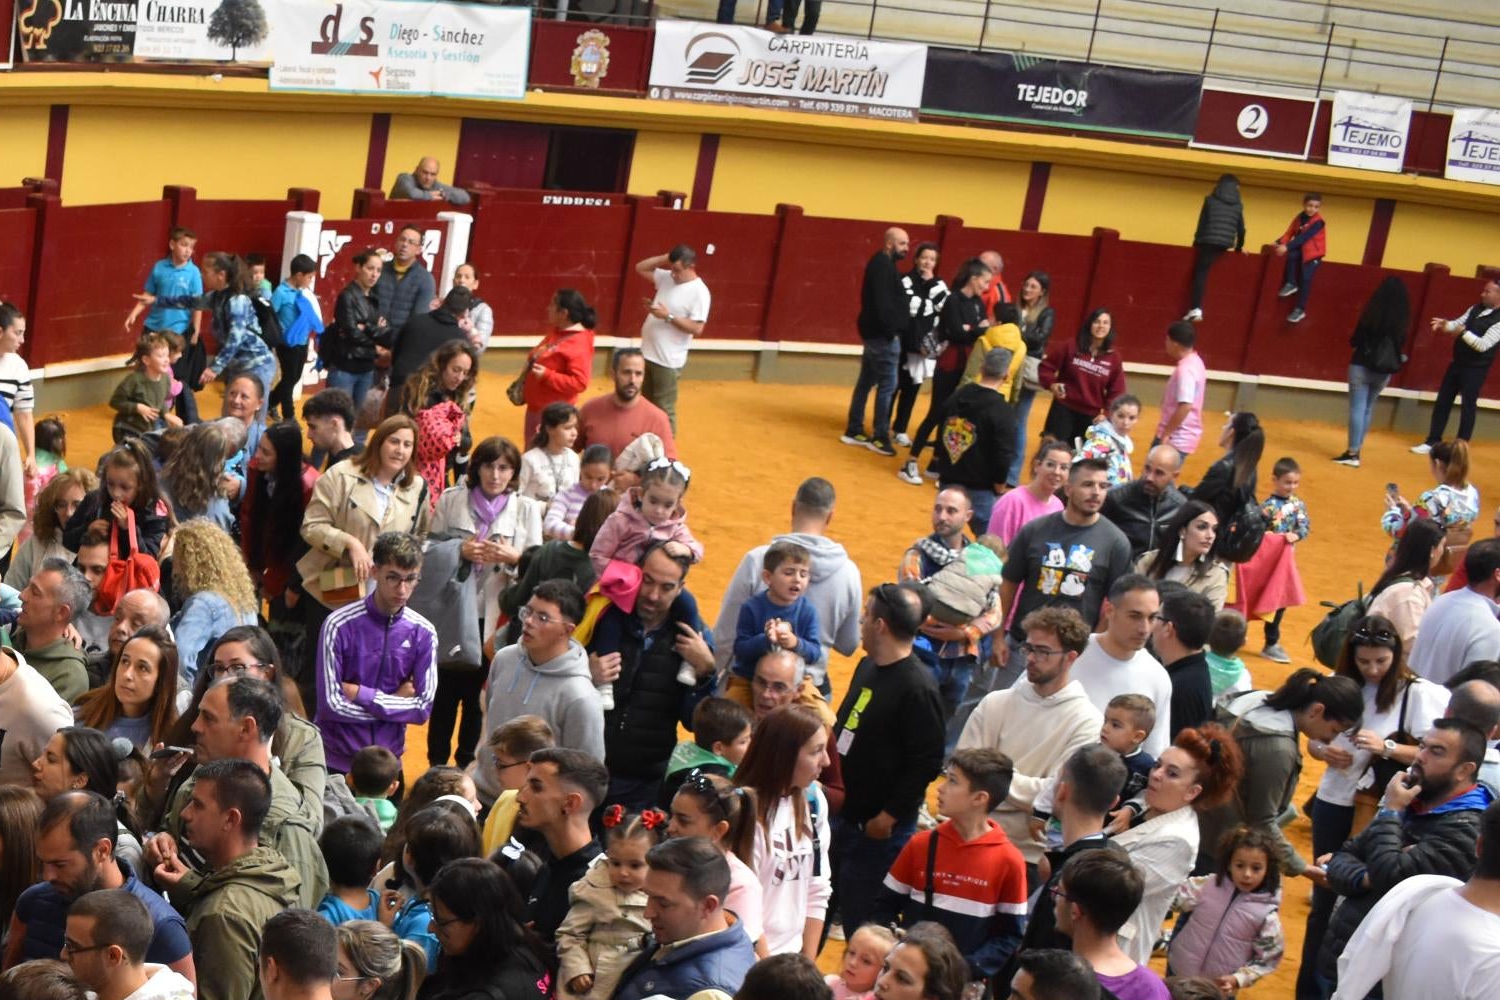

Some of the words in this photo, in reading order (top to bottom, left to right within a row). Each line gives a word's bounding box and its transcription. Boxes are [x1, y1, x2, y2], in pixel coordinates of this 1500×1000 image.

[63, 0, 84, 20] LA
[89, 0, 137, 21] ENCINA
[147, 0, 204, 24] CHARRA
[389, 23, 419, 46] Diego
[768, 36, 869, 60] CARPINTERÍA
[738, 58, 800, 90] JOSÉ
[800, 65, 889, 98] MARTÍN
[1017, 83, 1088, 107] TEJEDOR
[868, 106, 912, 119] MACOTERA
[1244, 106, 1261, 134] 2
[1334, 115, 1402, 149] TEJEMO
